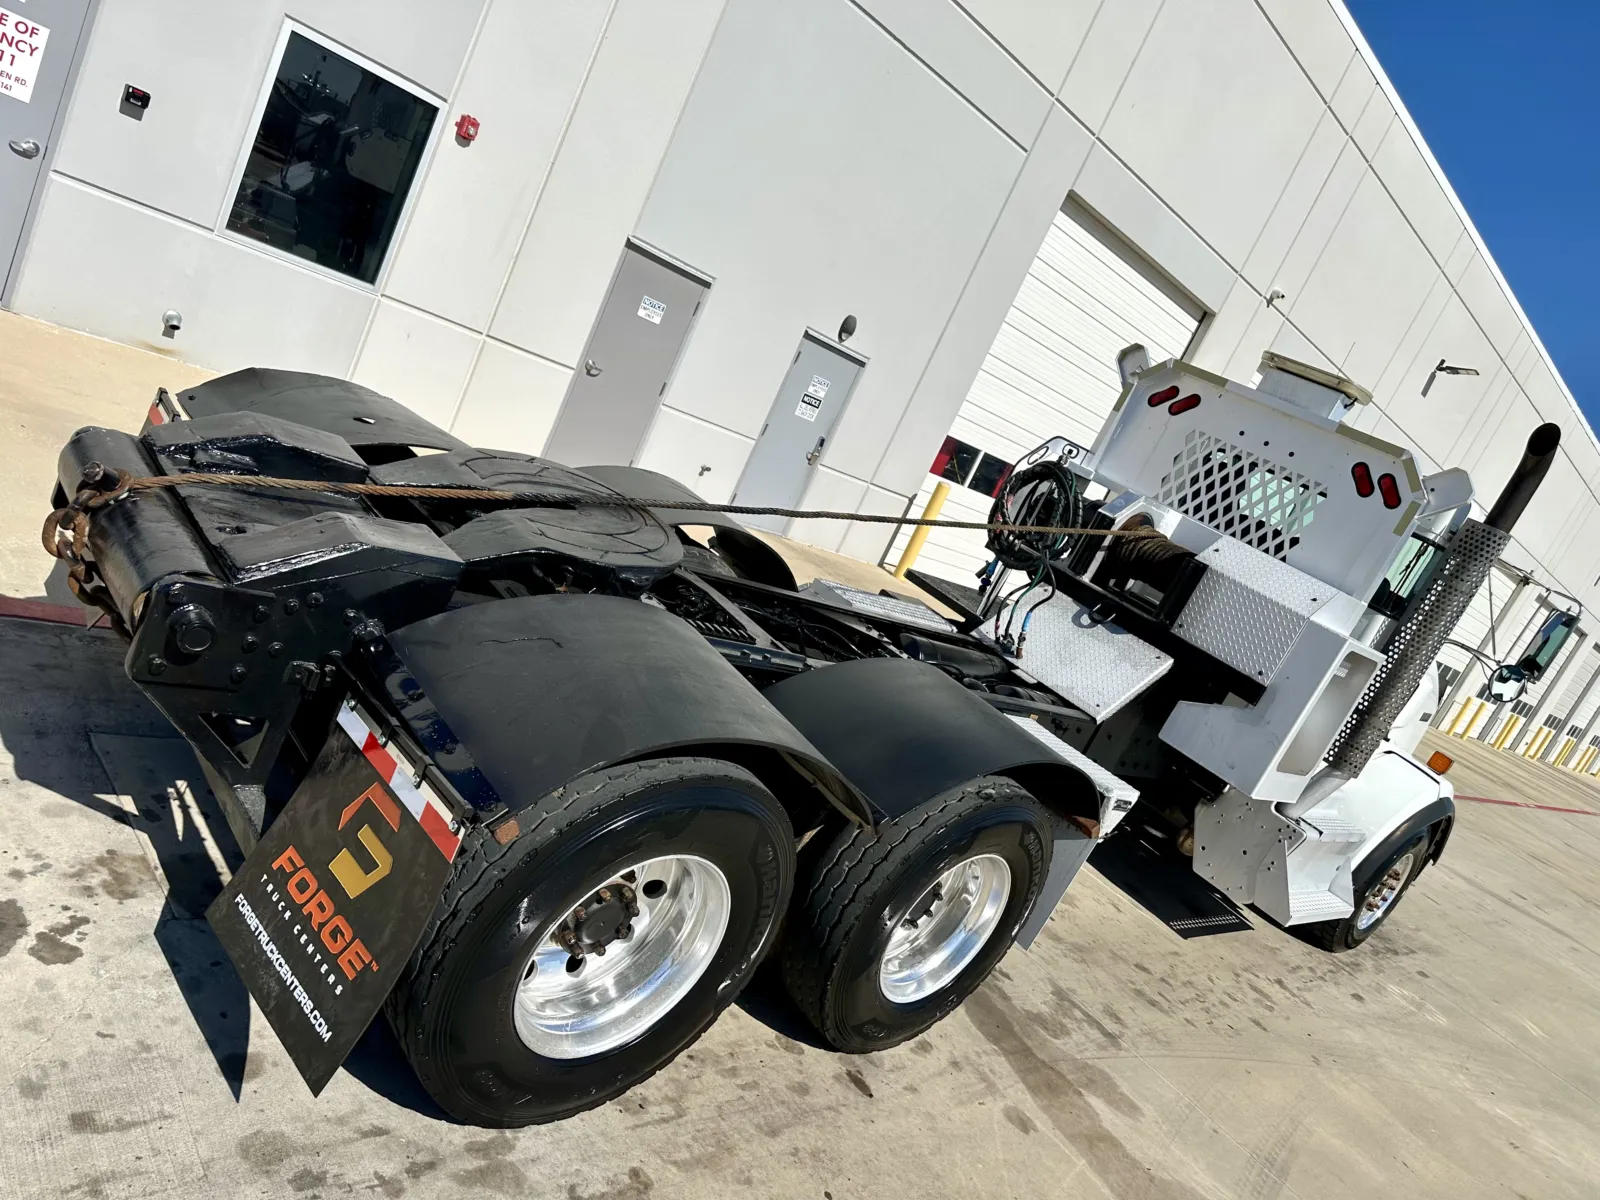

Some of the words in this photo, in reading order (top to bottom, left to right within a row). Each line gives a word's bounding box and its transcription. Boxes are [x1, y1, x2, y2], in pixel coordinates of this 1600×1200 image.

[14, 20, 40, 38] OF
[643, 297, 665, 312] NOTICE
[802, 395, 821, 408] NOTICE
[260, 873, 292, 921] TRUCK
[293, 924, 344, 996] CENTERS
[271, 845, 373, 981] FORGE
[234, 892, 333, 1043] FORGETRUCKCENTERS.COM
